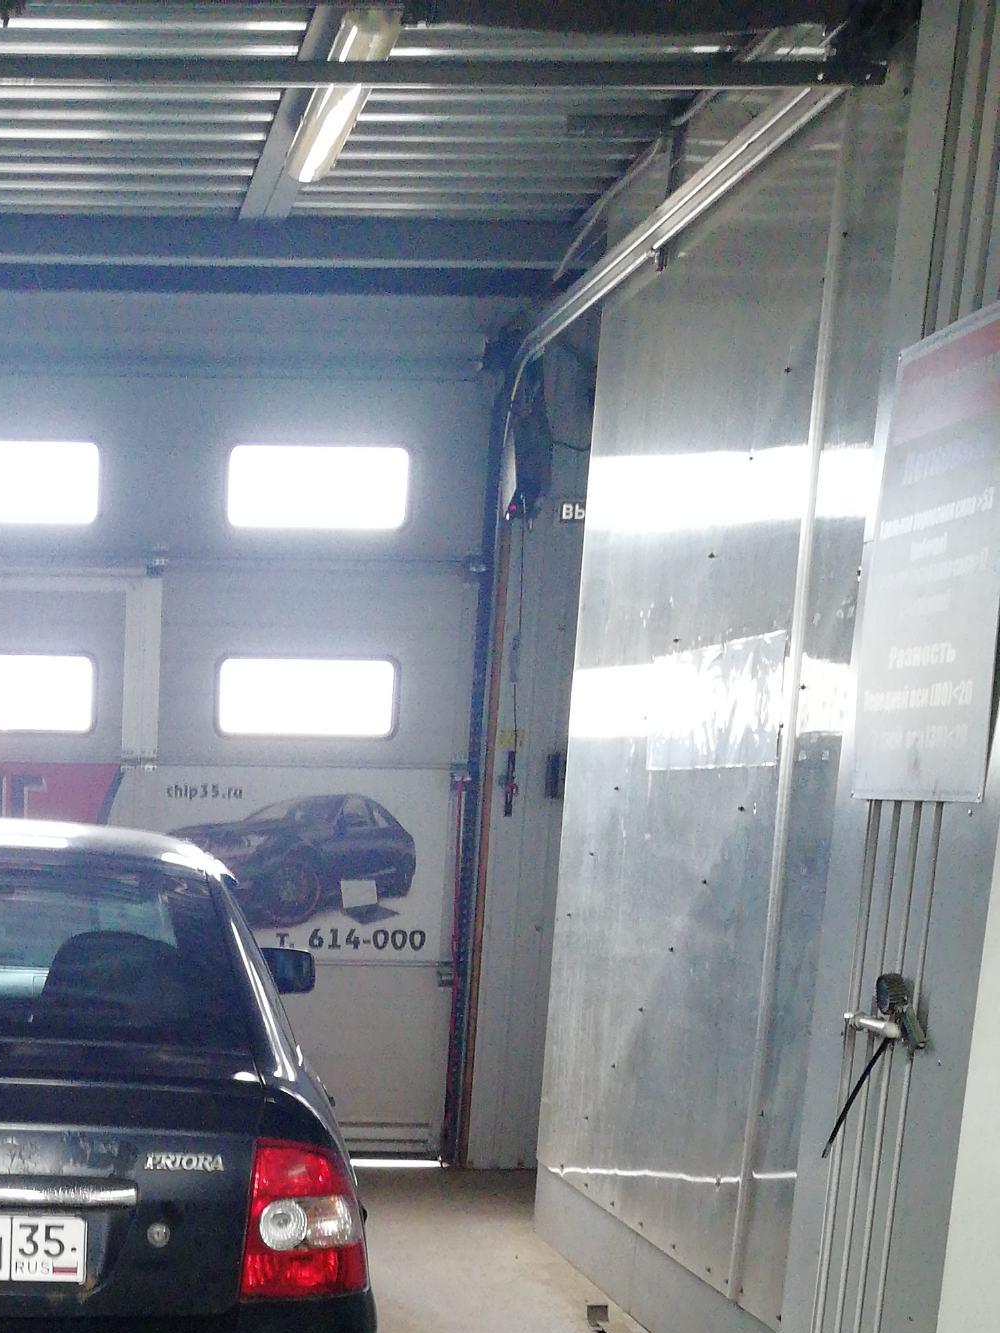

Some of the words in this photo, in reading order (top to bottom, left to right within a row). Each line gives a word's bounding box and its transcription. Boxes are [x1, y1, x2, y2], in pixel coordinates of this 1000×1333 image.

[166, 783, 243, 801] chip35.ru
[308, 928, 427, 951] 614-000
[143, 1151, 224, 1172] PRIORA
[18, 1223, 64, 1258] 35
[15, 1261, 50, 1276] RUS
